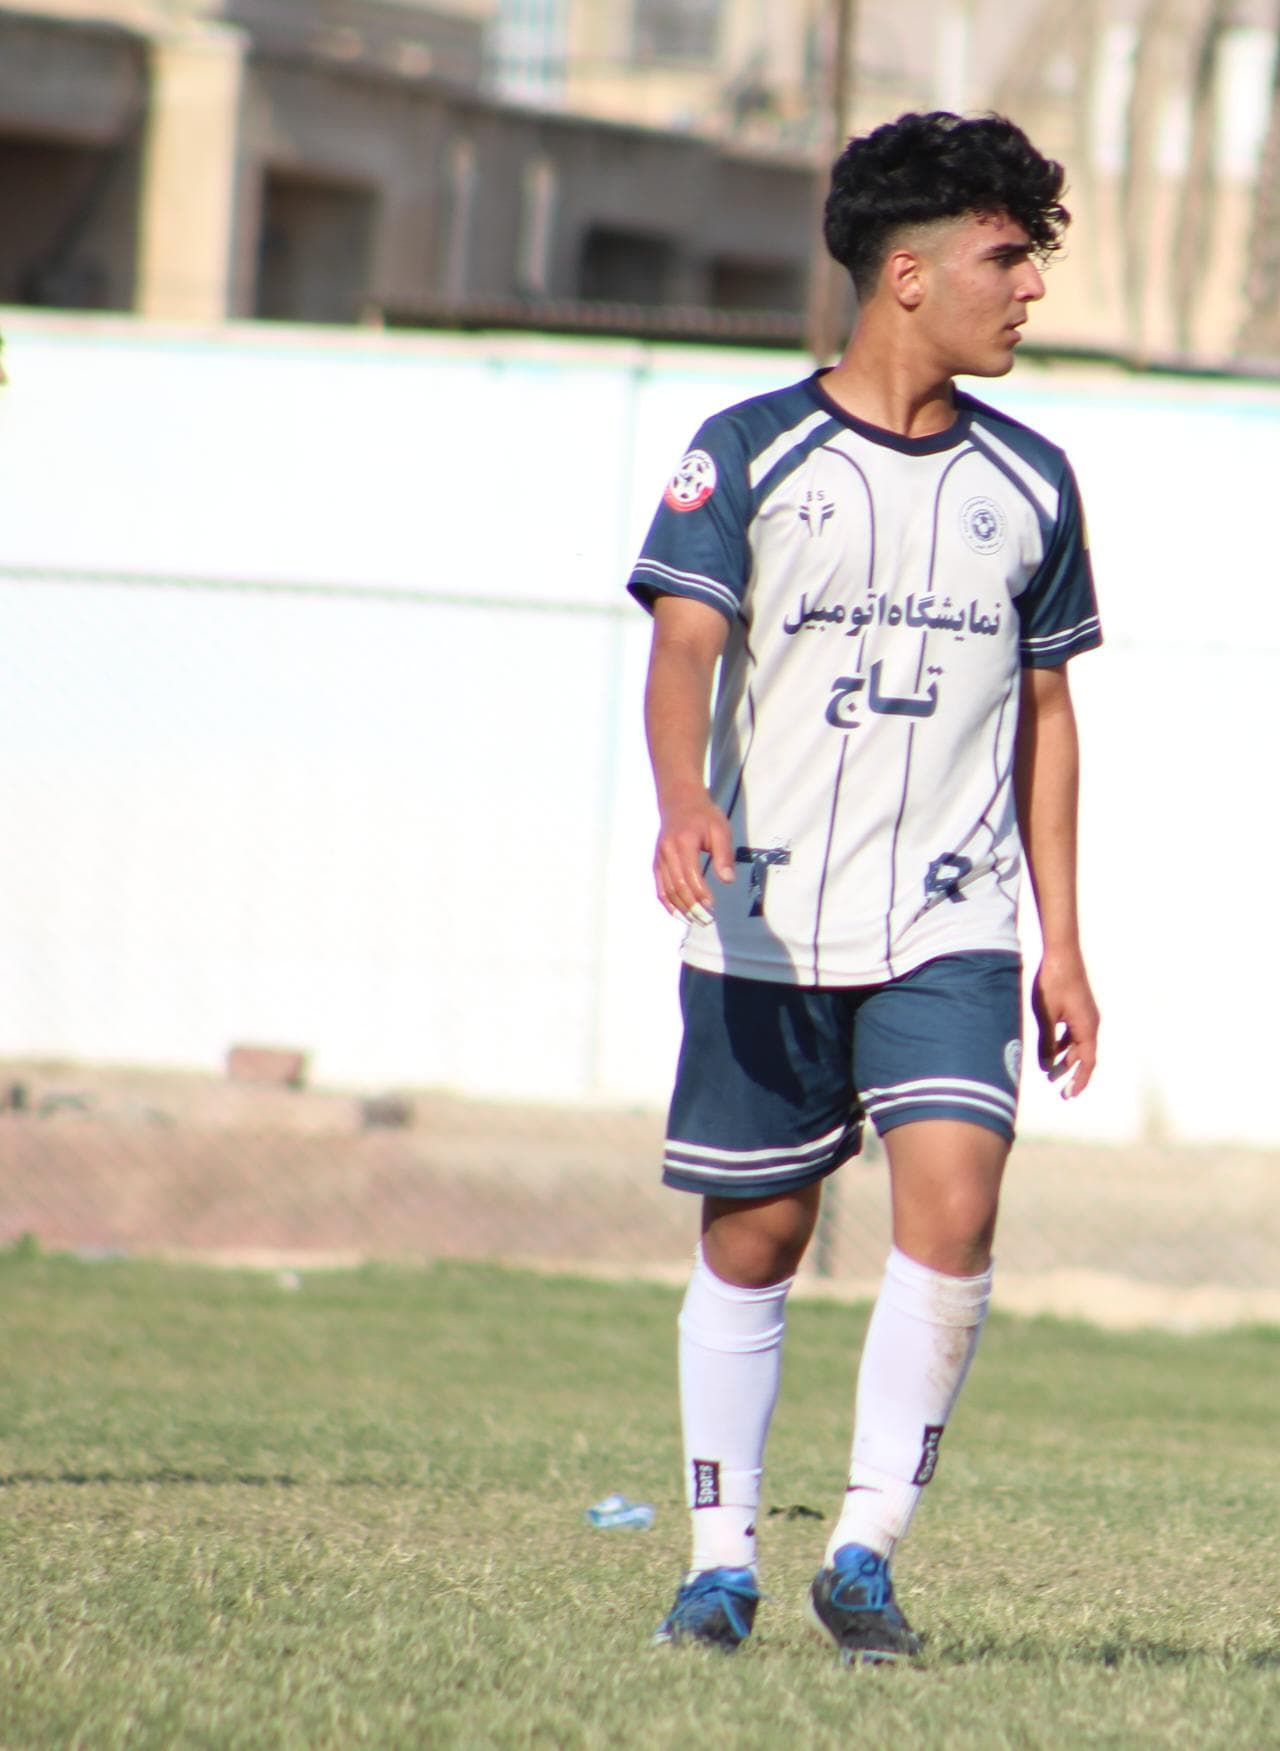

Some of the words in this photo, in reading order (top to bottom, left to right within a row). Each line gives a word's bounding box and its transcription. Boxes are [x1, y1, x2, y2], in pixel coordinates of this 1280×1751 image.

[783, 592, 888, 636] اتومبیل
[888, 593, 1001, 641] نمایشگاه
[825, 659, 944, 729] تاج
[736, 846, 791, 917] T
